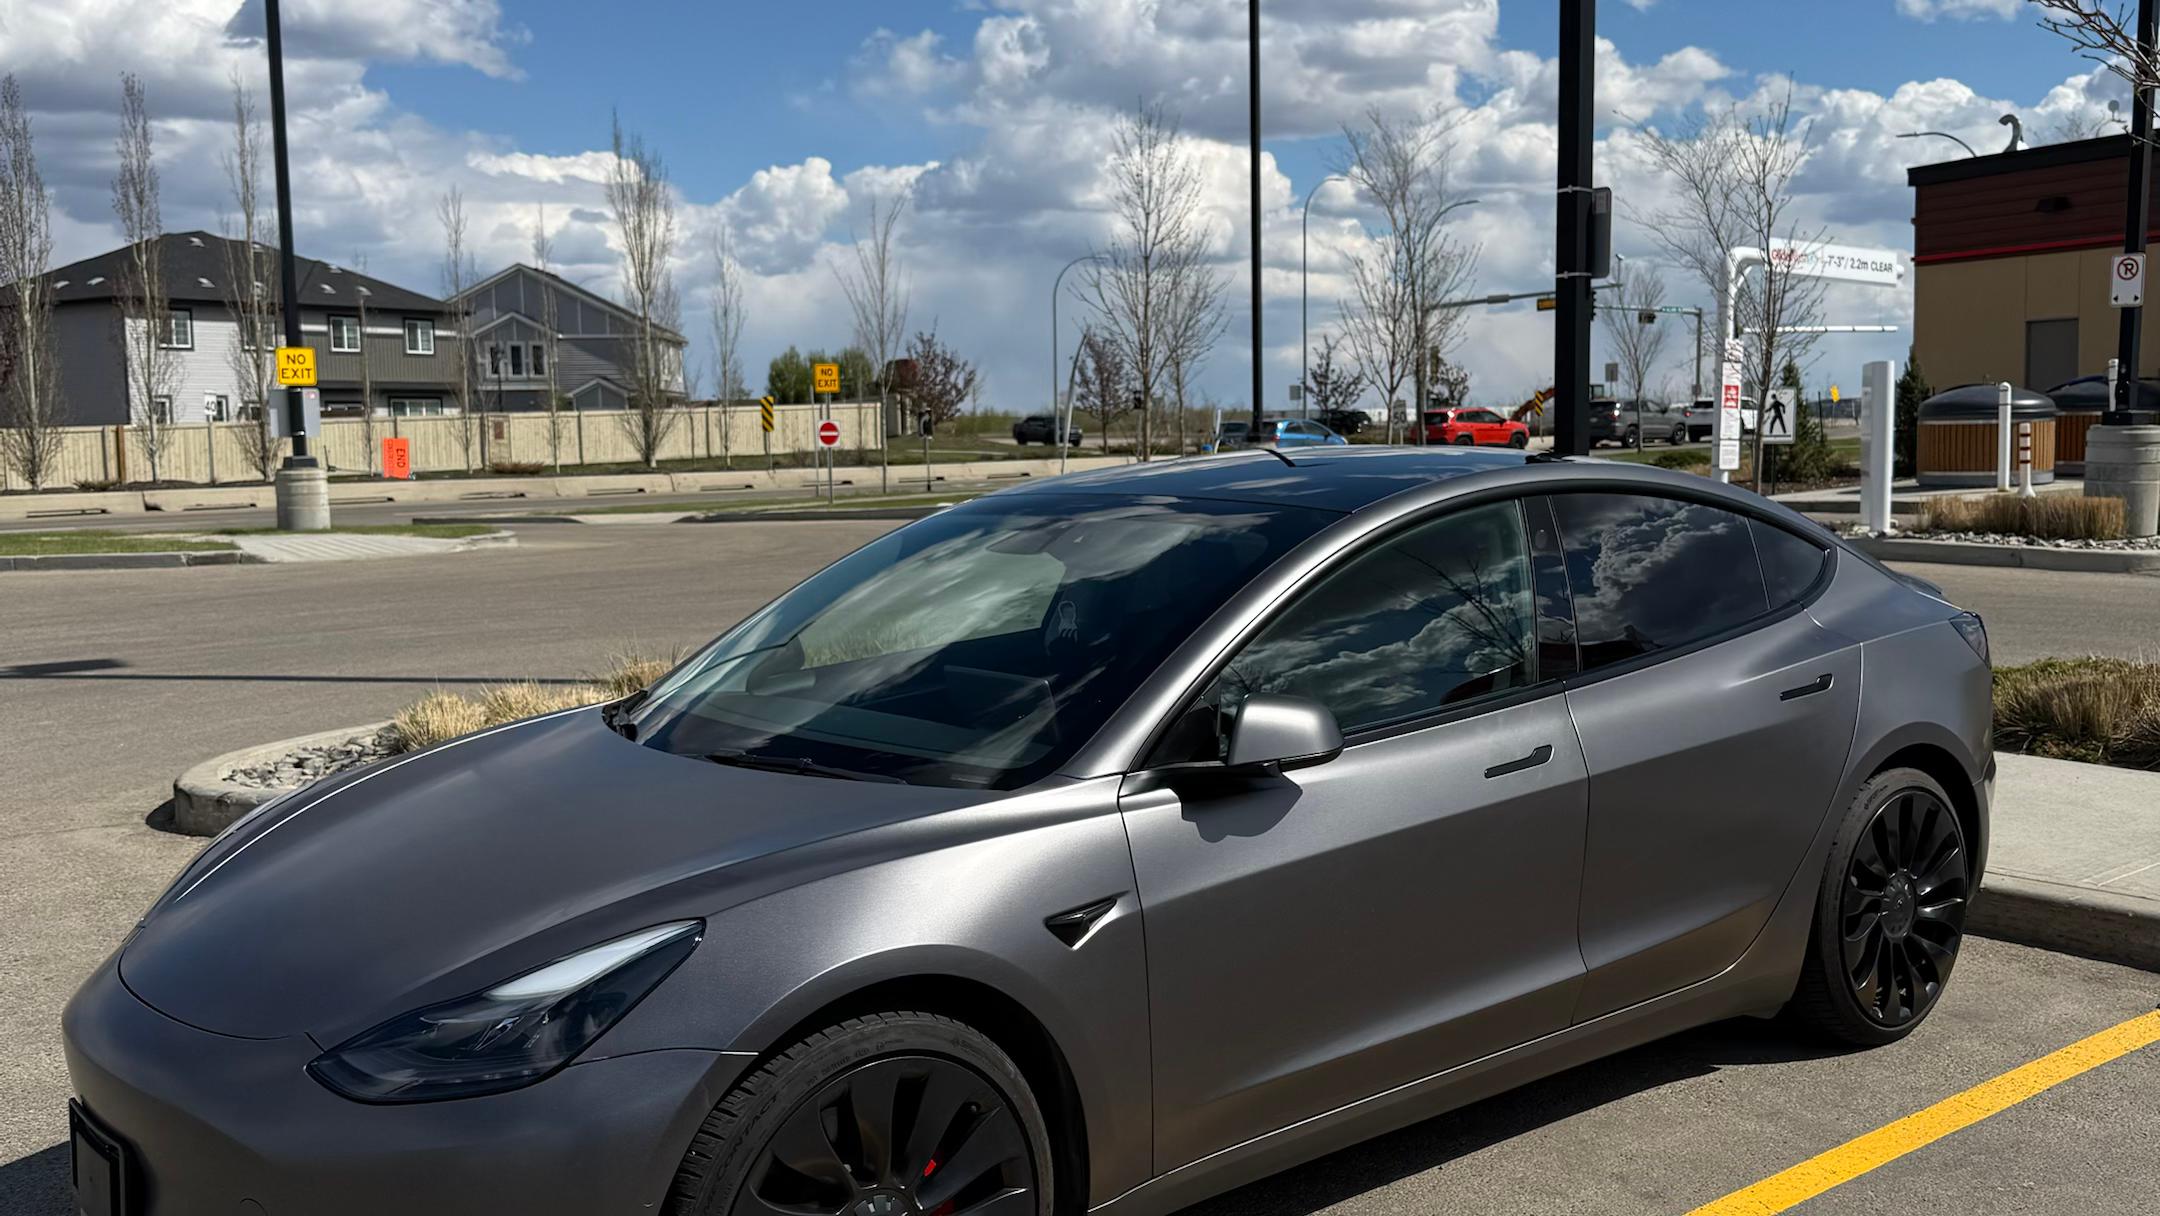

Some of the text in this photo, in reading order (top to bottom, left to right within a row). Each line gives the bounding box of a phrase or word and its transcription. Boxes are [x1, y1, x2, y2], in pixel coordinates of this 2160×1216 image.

[1850, 257, 1869, 270] 2.2m
[1870, 260, 1893, 273] CLEAR
[286, 353, 306, 365] NO
[281, 367, 312, 379] EXIT
[821, 368, 833, 377] NO
[818, 379, 837, 388] EXIT
[205, 401, 217, 412] 40
[396, 448, 406, 468] END
